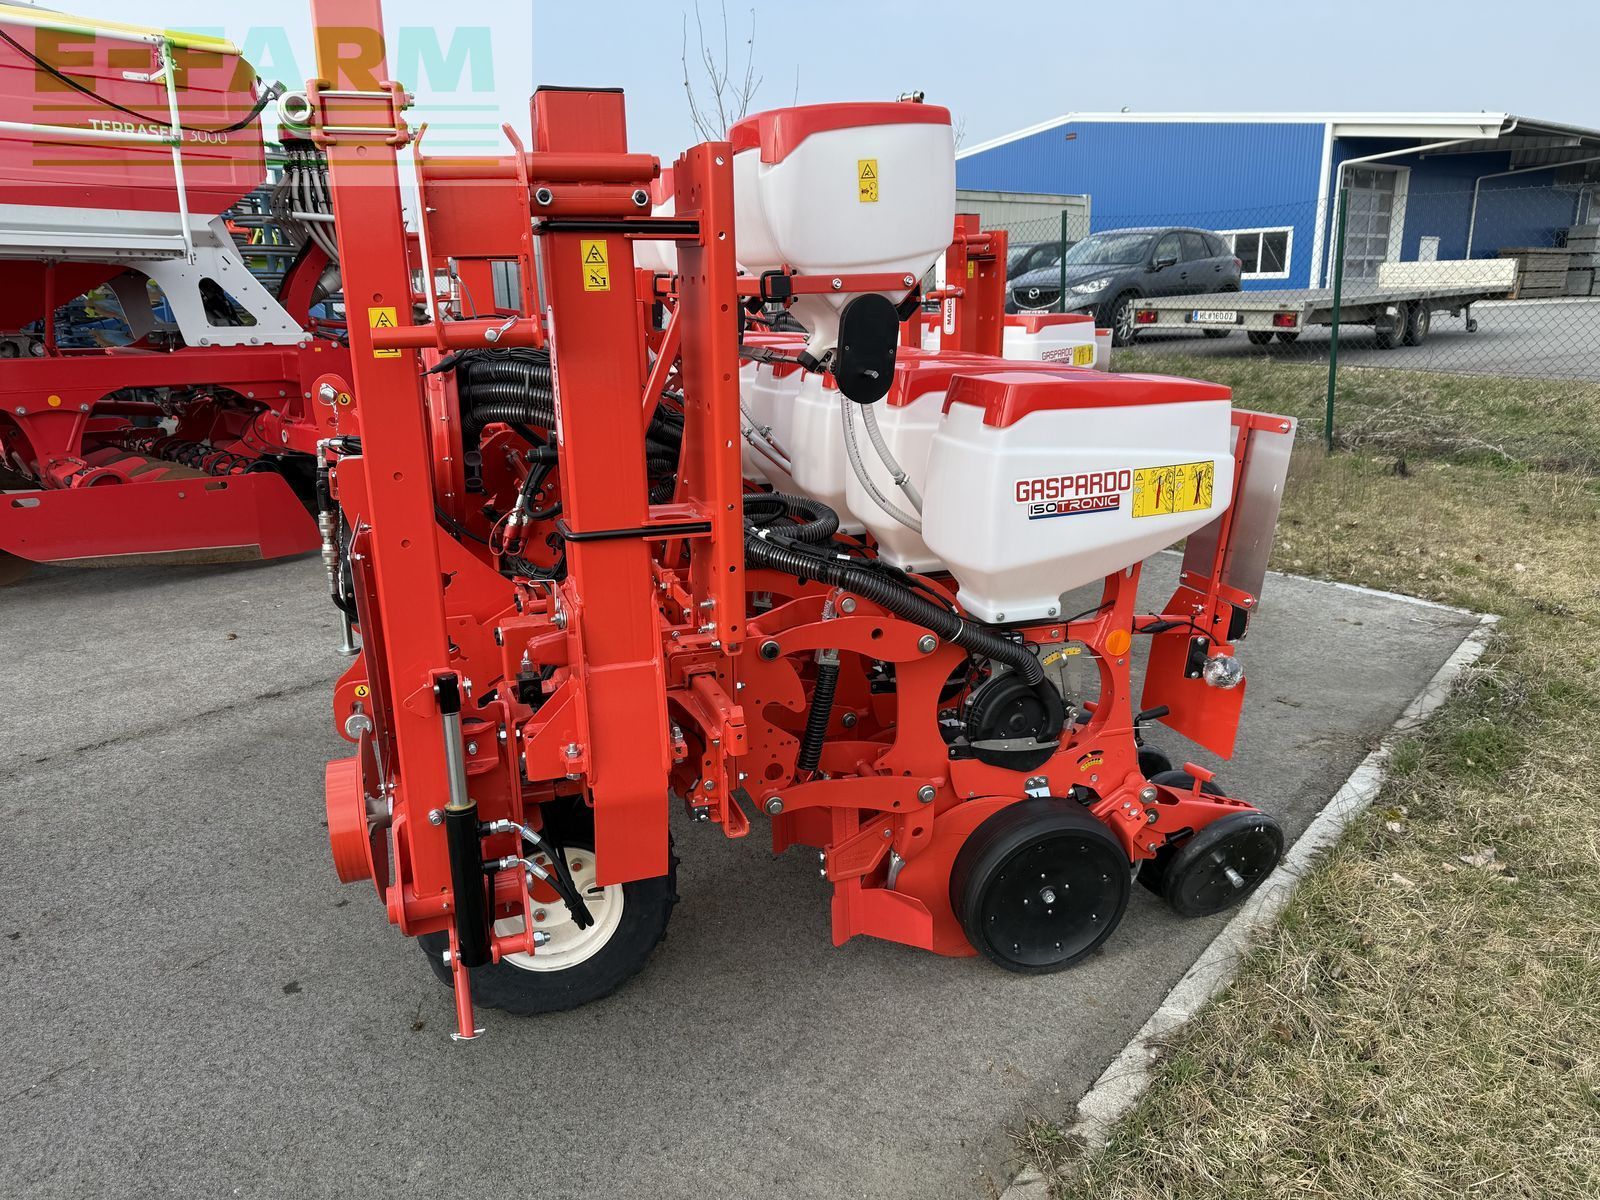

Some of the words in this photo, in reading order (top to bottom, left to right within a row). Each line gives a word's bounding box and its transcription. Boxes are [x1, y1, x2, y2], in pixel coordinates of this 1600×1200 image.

[190, 130, 228, 145] 3000
[1041, 347, 1073, 361] GASPARDO
[1016, 469, 1131, 503] GASPARDO
[1030, 495, 1119, 515] ISOTRONIC
